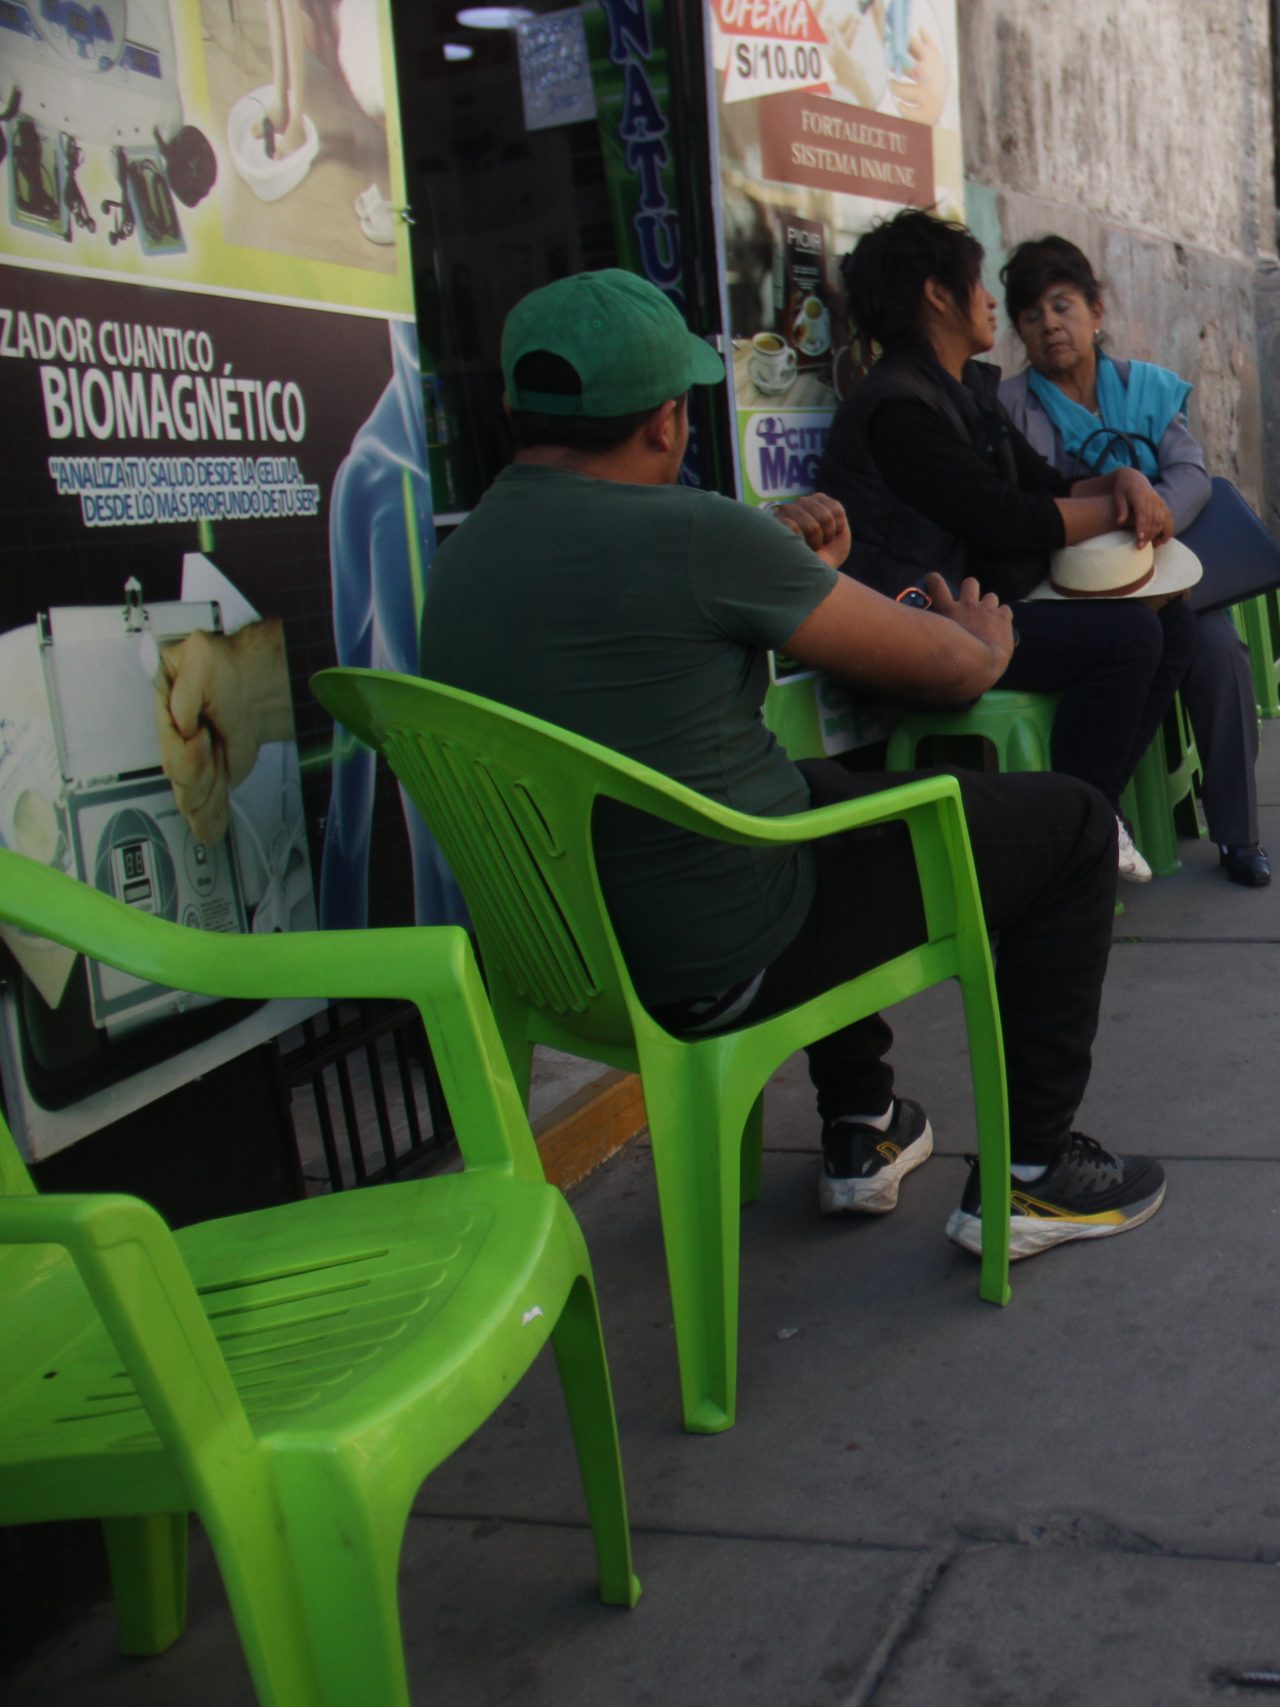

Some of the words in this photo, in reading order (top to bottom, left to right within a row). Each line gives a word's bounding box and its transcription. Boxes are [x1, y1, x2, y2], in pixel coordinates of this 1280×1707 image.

[801, 109, 886, 150] FORTALECE
[888, 131, 907, 155] TU
[791, 141, 858, 177] SISTEMA
[860, 157, 916, 188] INMUNE
[0, 309, 96, 363] ZADOR
[99, 321, 214, 372] CUANTICO
[40, 363, 306, 442] BIOMAGNÉTICO
[125, 461, 148, 488] TU
[149, 460, 195, 487] SALUD
[197, 460, 239, 486] DESDE
[239, 460, 256, 485] LA
[82, 493, 135, 522] DESDE
[136, 492, 155, 519] LO
[189, 489, 261, 518] PROFUNDO
[261, 489, 279, 514] DE
[278, 488, 296, 513] TU
